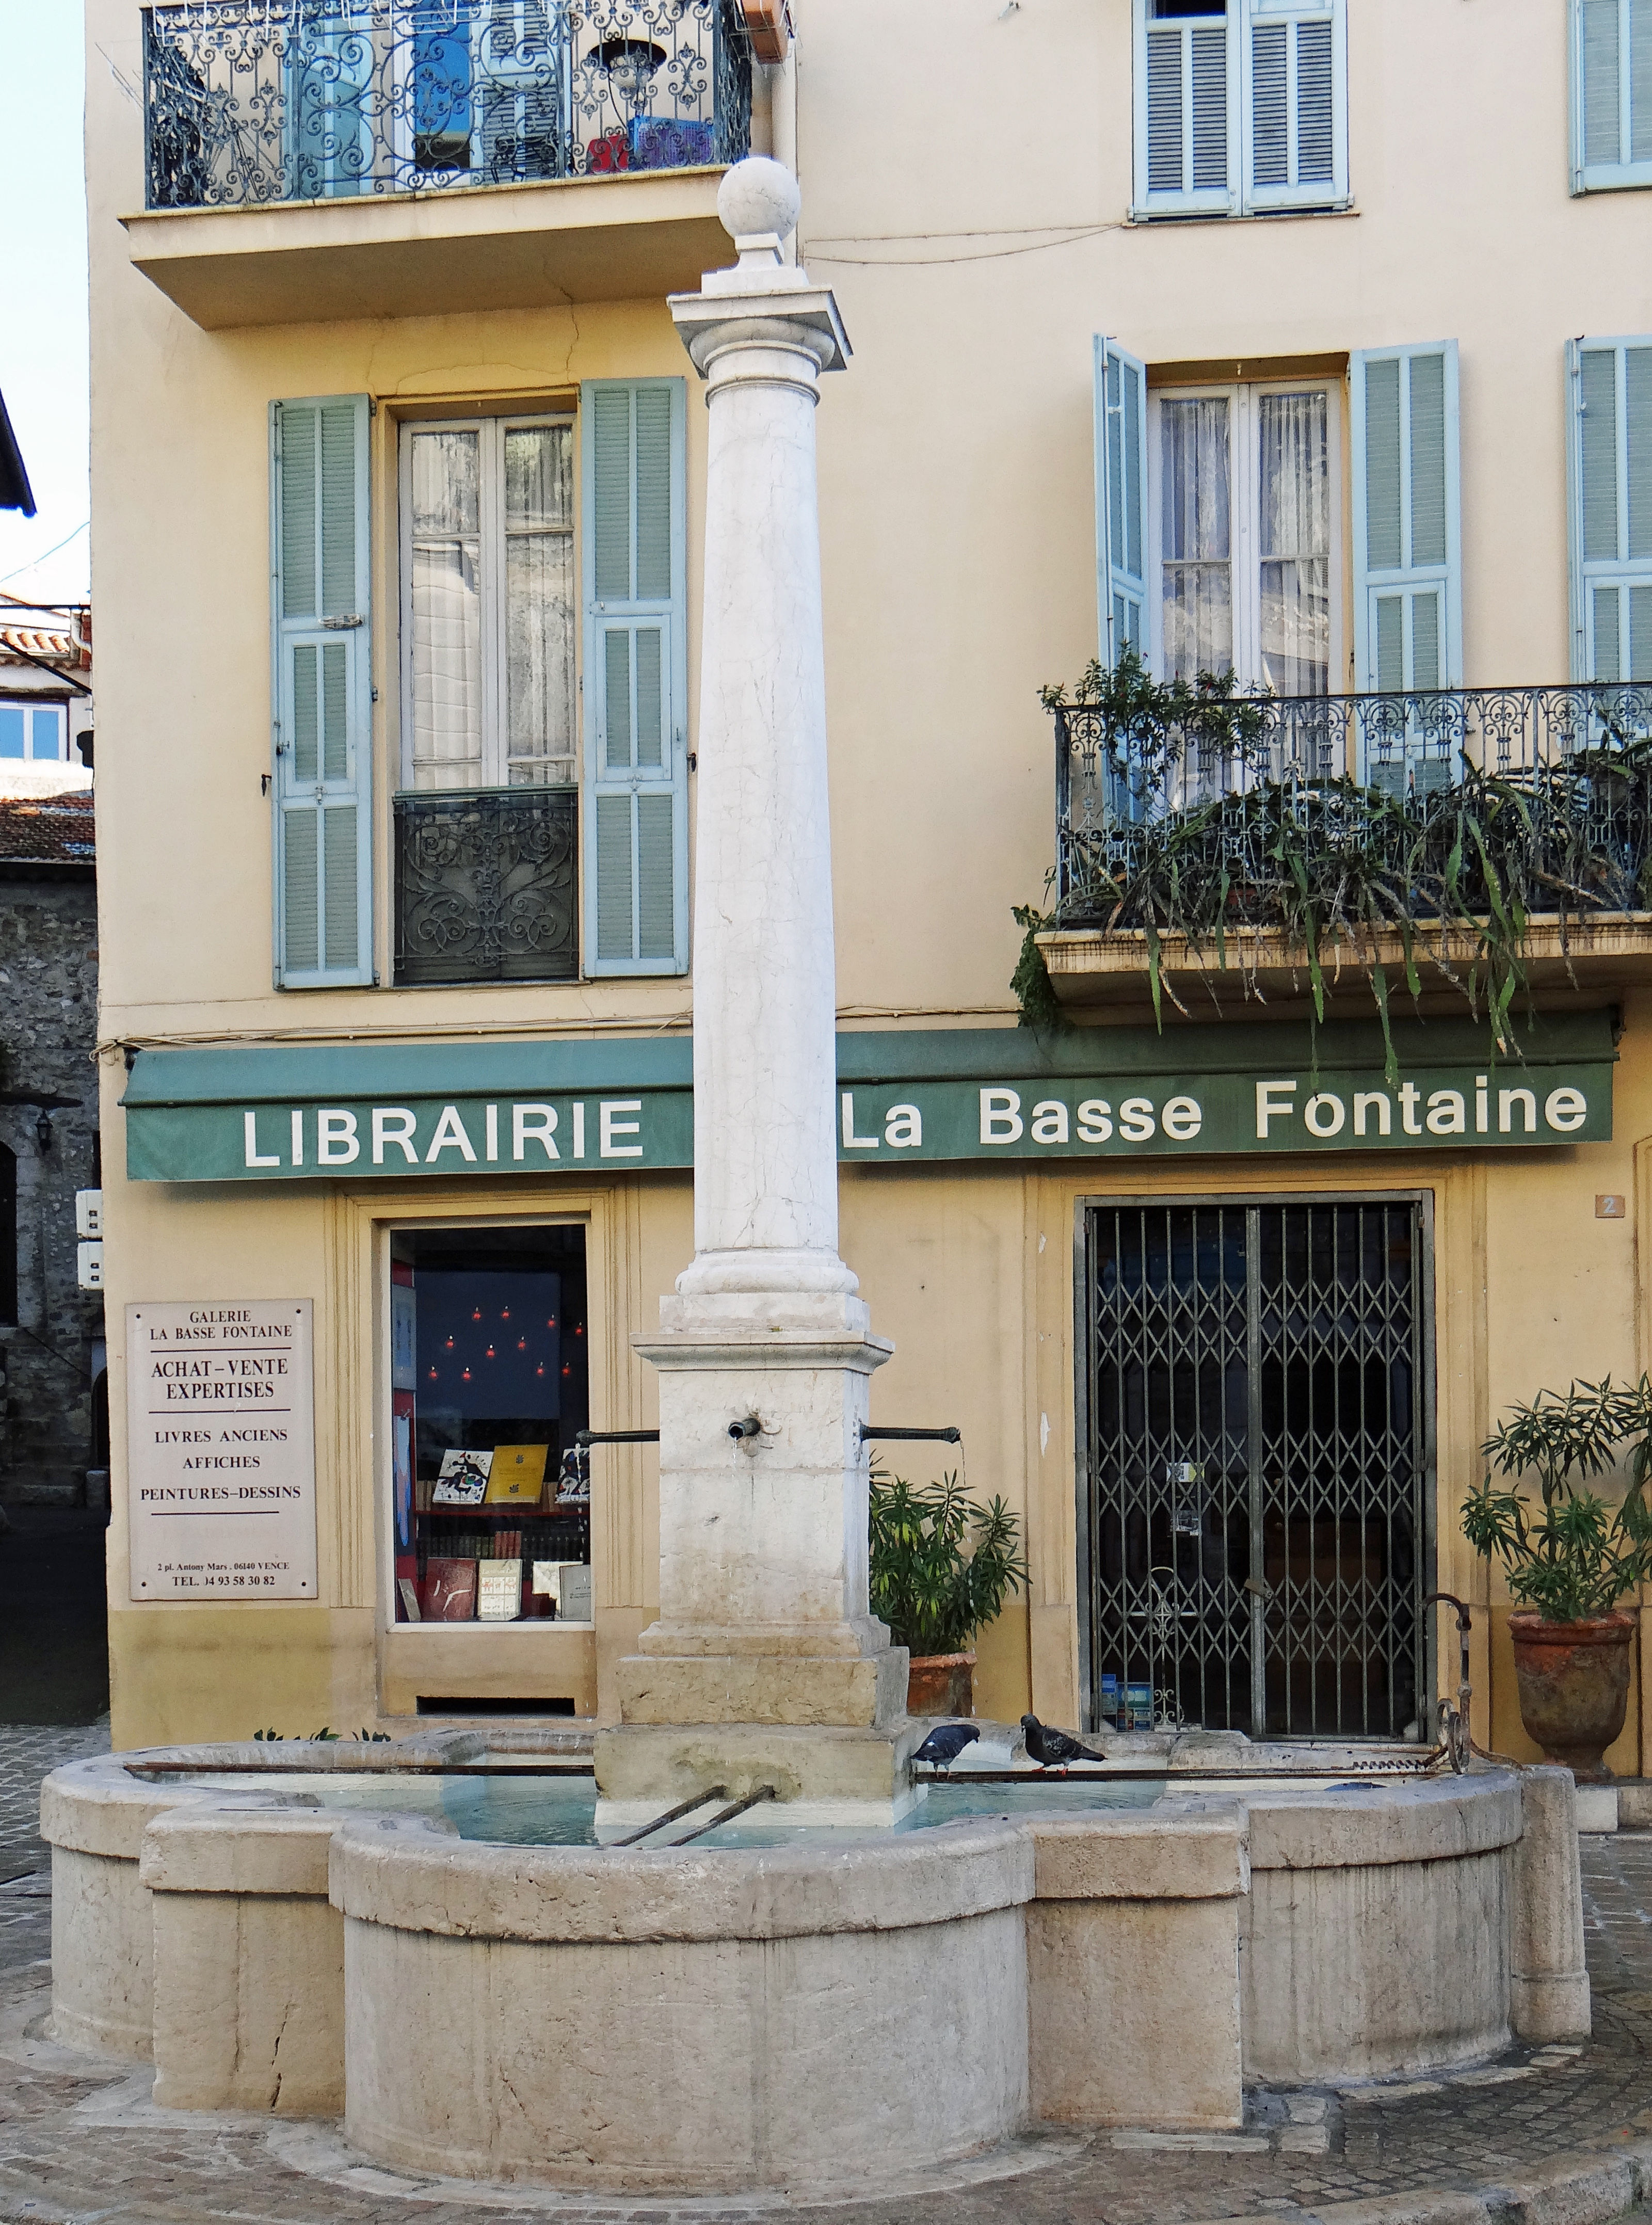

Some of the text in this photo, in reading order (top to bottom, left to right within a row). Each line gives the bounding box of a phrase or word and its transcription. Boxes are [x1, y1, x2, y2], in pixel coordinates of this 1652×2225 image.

[244, 1075, 1587, 1167] LIBRAIRIE La Basse Fontaine
[1603, 1197, 1615, 1213] 2
[189, 1310, 251, 1323] GALERIE
[150, 1325, 292, 1340] LA BASSE FONTAINE
[166, 1381, 274, 1400] EXPERTISES
[154, 1429, 287, 1443] LIVRES ANCIENS
[182, 1455, 260, 1469] AFFICHES
[176, 1563, 205, 1572] Antony
[258, 1562, 290, 1570] VENCE
[172, 1576, 200, 1587] TEL.
[218, 1576, 230, 1586] 93
[233, 1576, 245, 1586] 58
[248, 1575, 260, 1586] 30
[263, 1575, 275, 1586] 82
